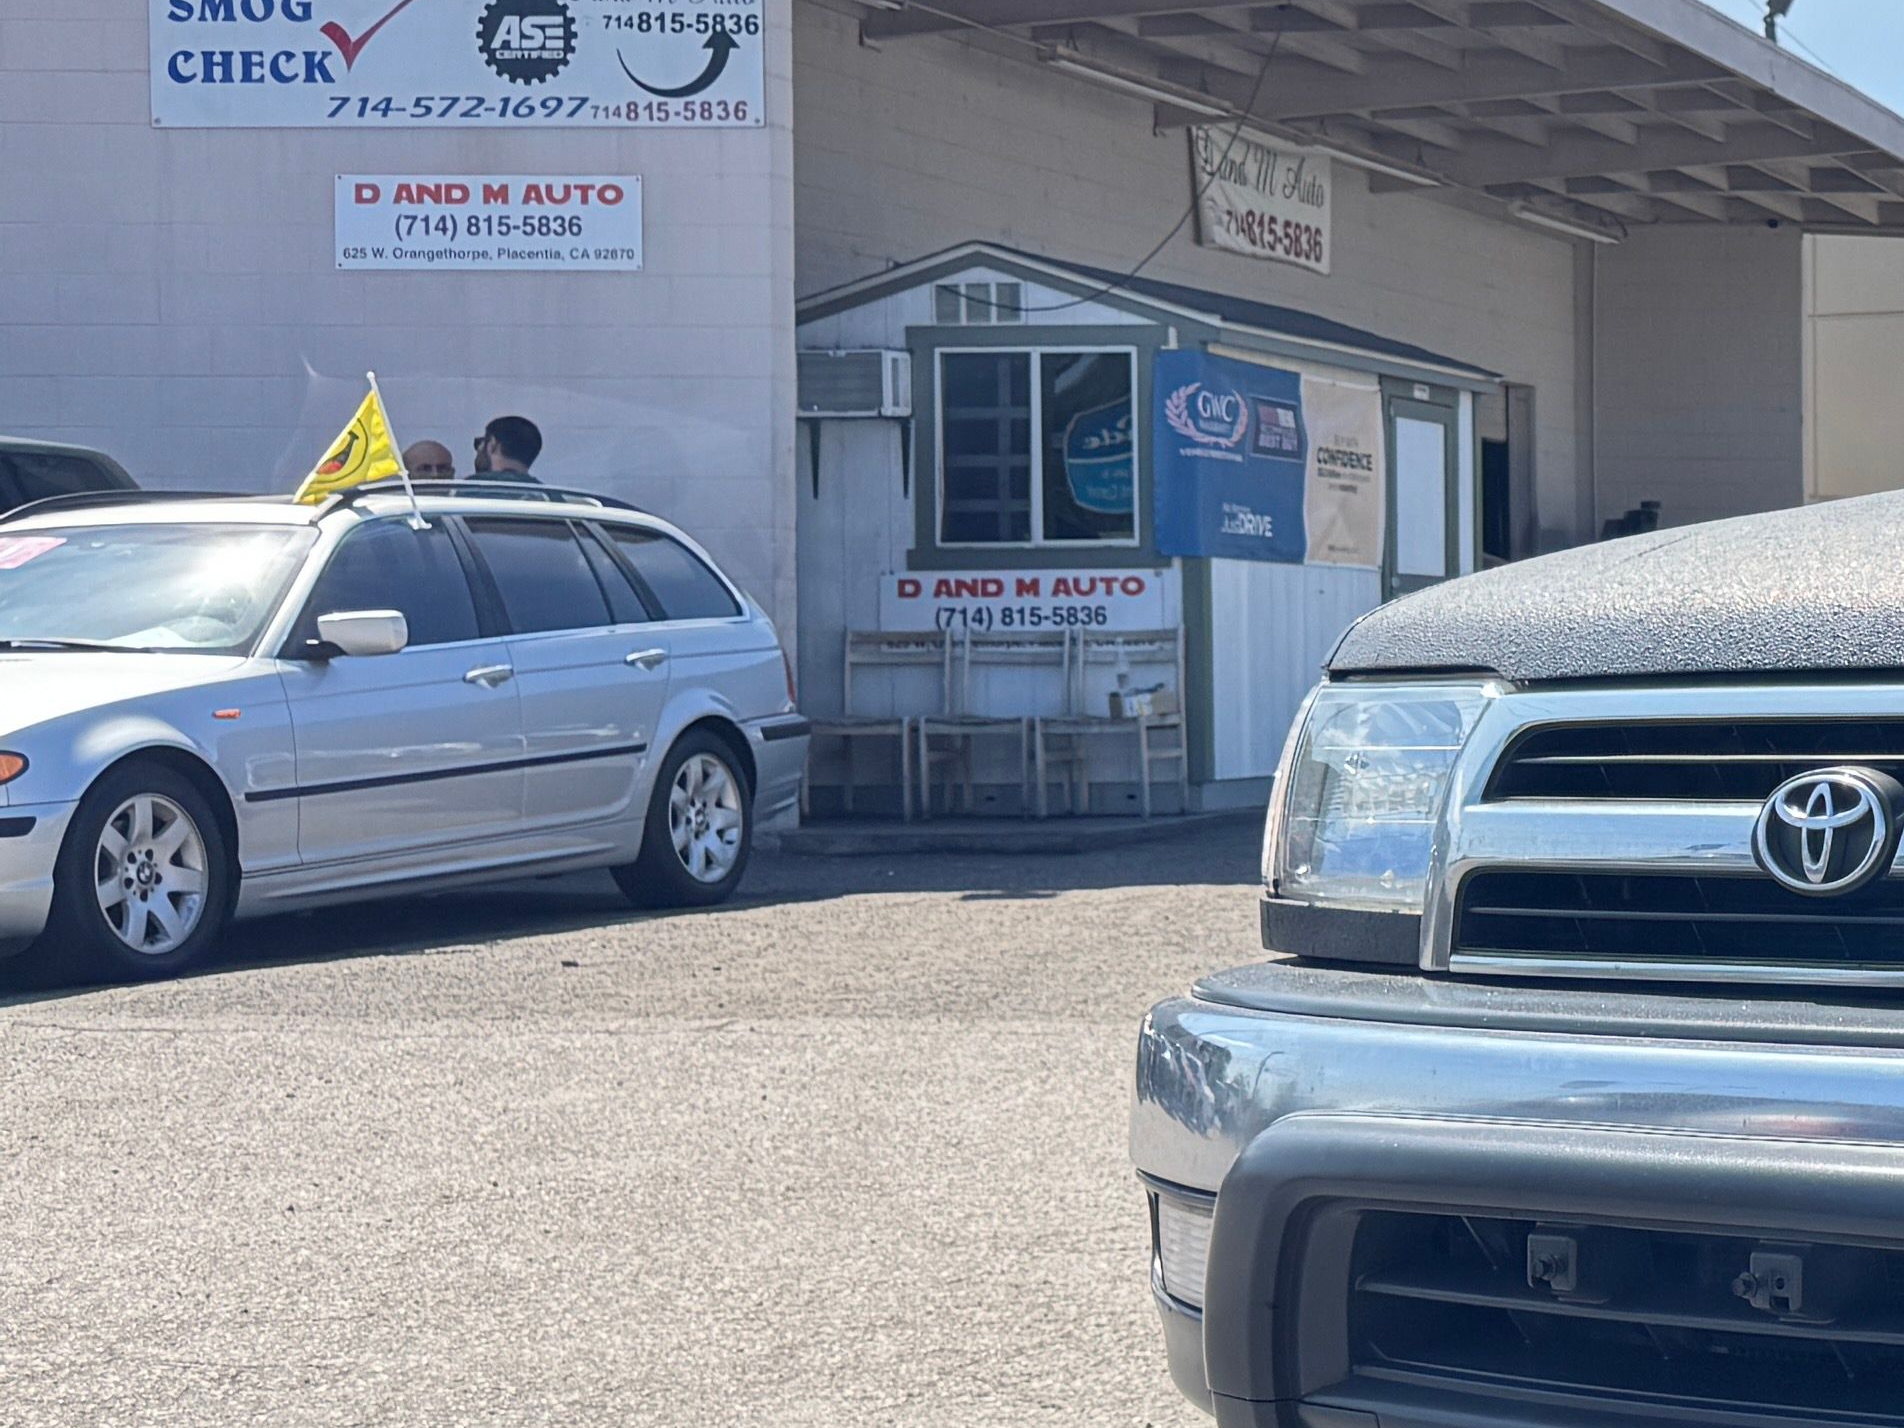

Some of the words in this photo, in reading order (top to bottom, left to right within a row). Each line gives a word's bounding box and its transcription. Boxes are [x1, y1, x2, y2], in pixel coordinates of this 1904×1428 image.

[490, 15, 565, 49] ASE
[167, 50, 336, 84] CHECK
[495, 50, 565, 60] CERTIFIED
[327, 96, 590, 118] 714-572-1697
[355, 183, 381, 205] D
[393, 183, 471, 205] AND
[482, 183, 509, 205] M
[522, 183, 624, 206] AUTO
[1282, 157, 1325, 209] Auto
[394, 214, 458, 242] (714)
[466, 215, 583, 237] 815-5836
[343, 247, 368, 260] 625
[371, 248, 389, 260] W.
[569, 247, 590, 260] CA
[897, 578, 922, 599] D
[933, 577, 1005, 598] AND
[1015, 577, 1040, 598] M
[1051, 575, 1146, 598] AUTO
[935, 606, 993, 631] (714)
[1000, 605, 1107, 627] 815-5836
